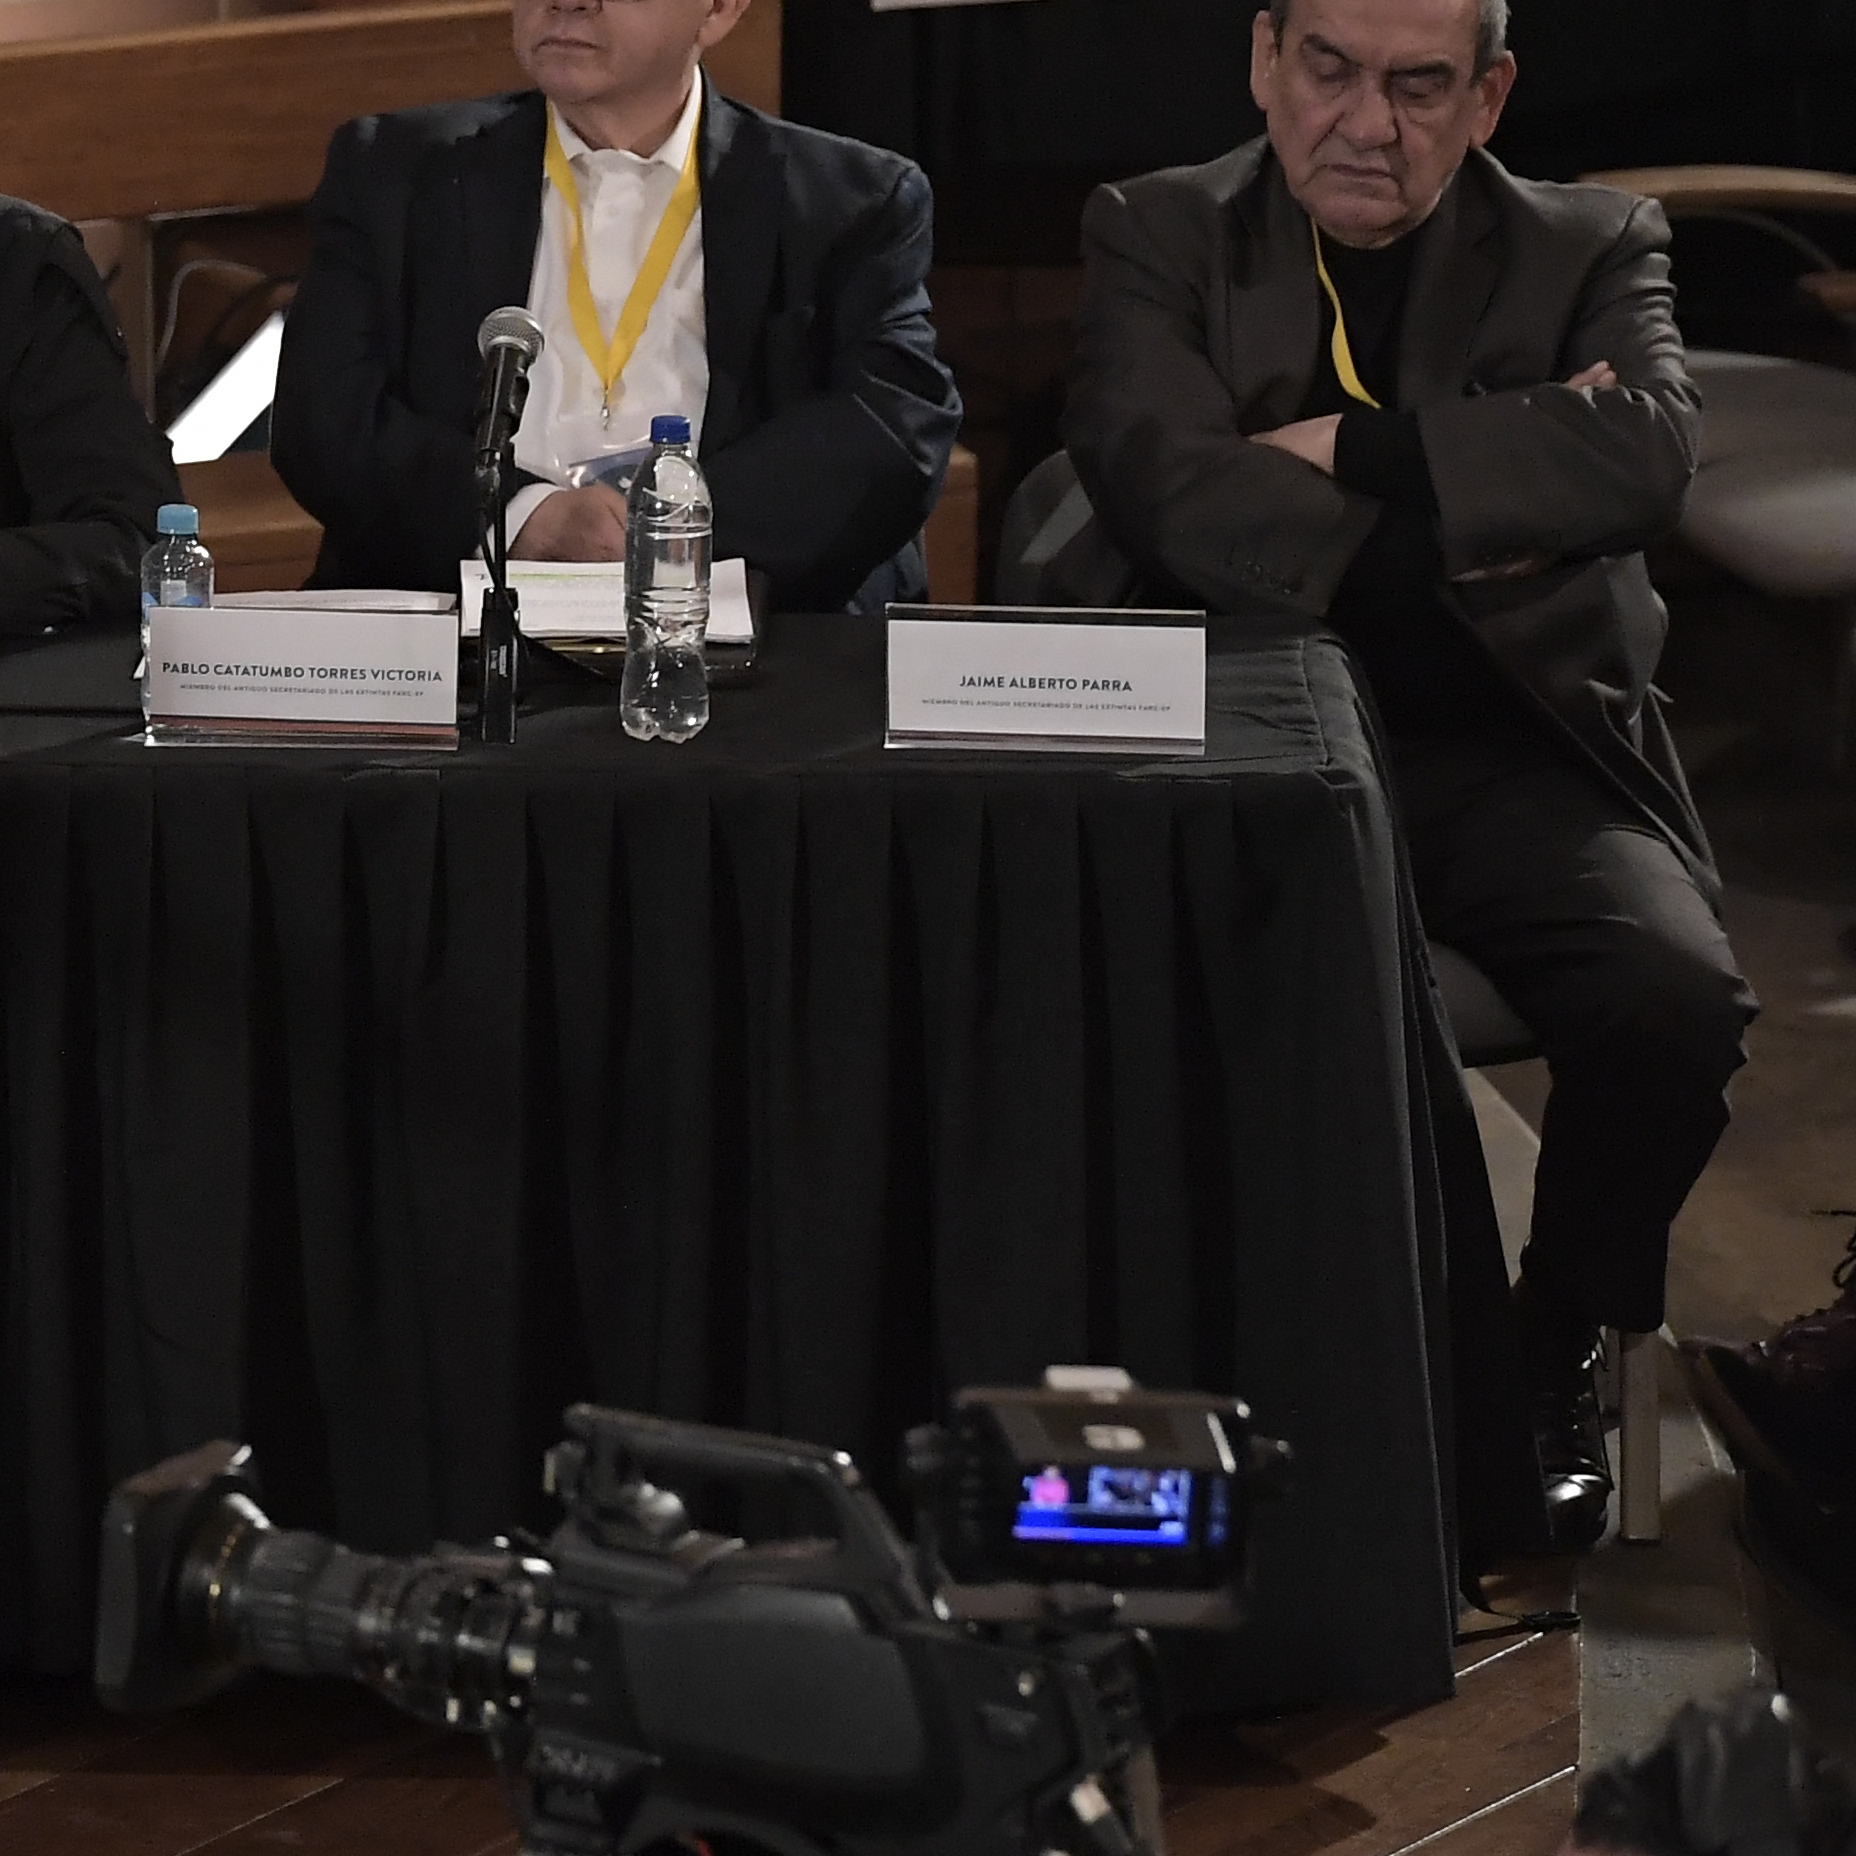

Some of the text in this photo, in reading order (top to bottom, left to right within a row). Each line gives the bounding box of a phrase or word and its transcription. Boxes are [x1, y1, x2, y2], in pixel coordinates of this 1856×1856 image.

[162, 662, 442, 681] PABLO CATATUMBO TORRES VICTORIA
[960, 676, 1132, 691] JAIME ALBERTO PARRA
